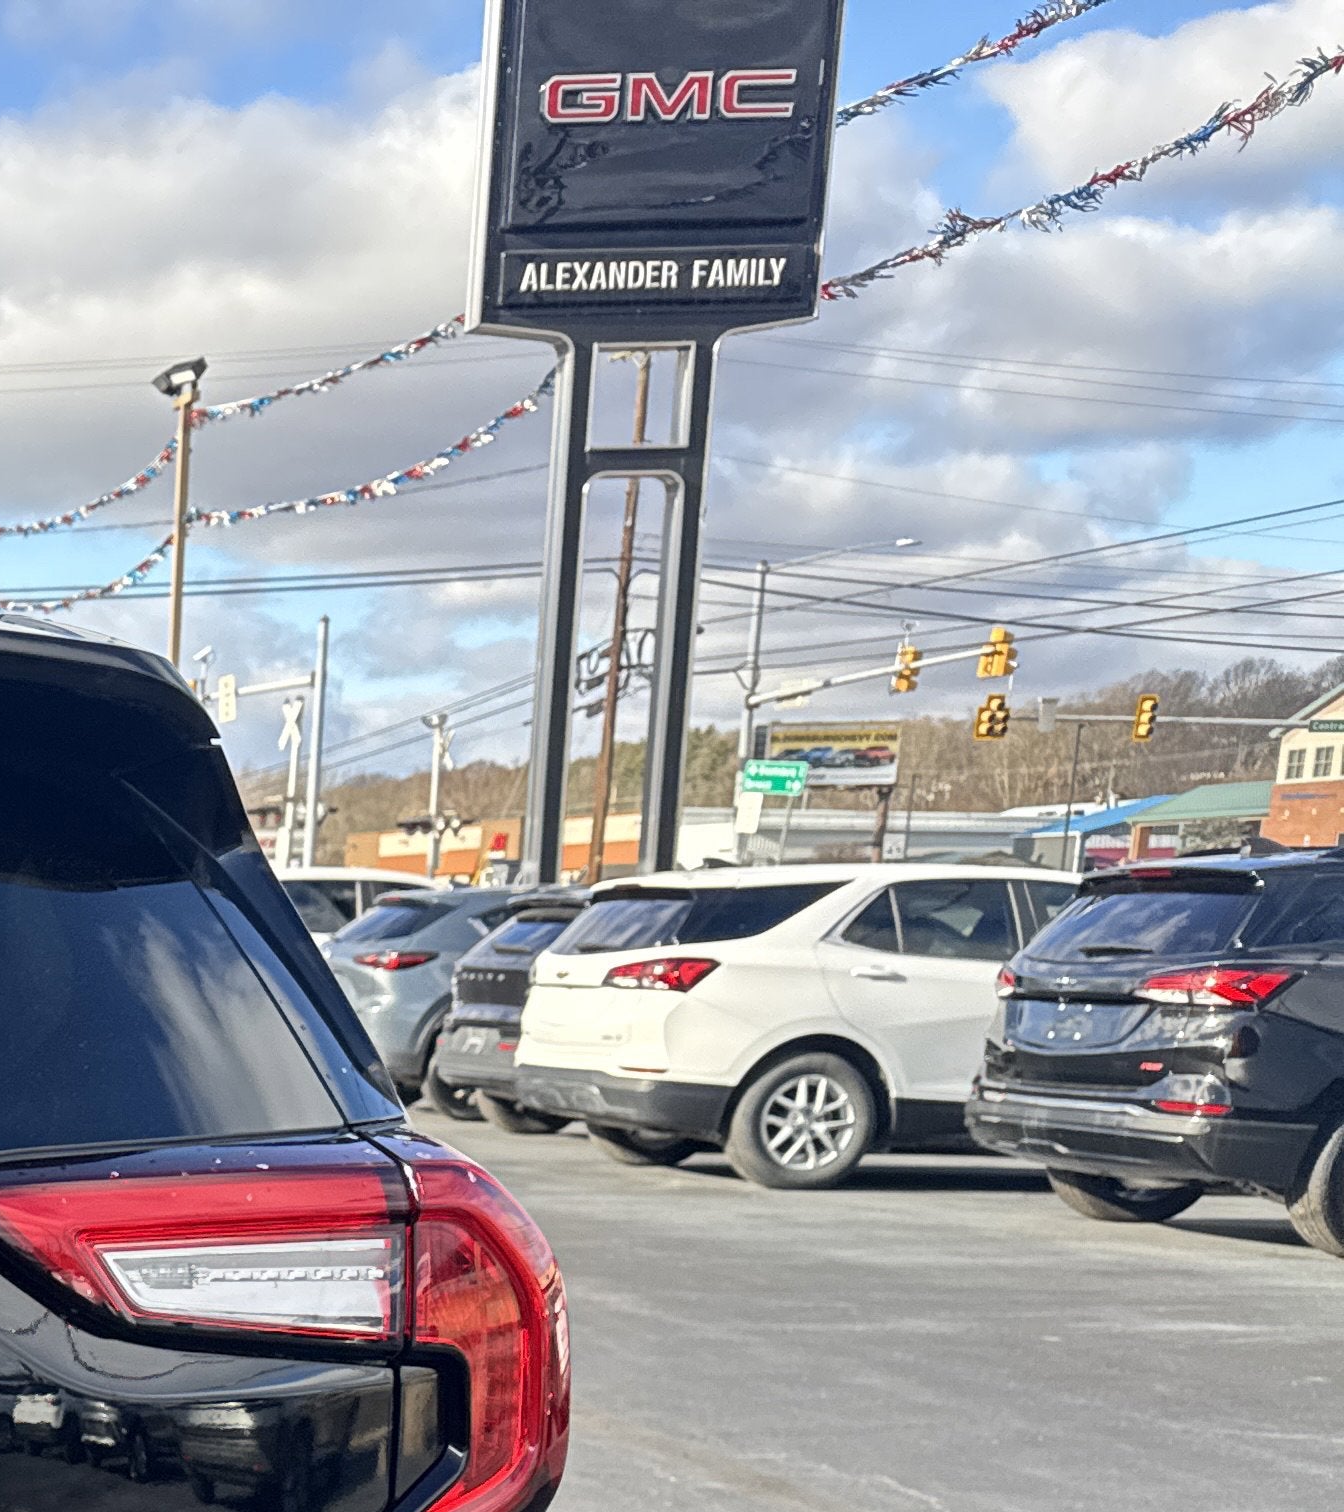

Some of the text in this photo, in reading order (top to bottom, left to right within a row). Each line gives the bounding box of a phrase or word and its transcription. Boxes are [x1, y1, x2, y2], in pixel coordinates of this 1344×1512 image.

[542, 69, 798, 123] GMC
[519, 257, 787, 292] ALEXANDER FAMILY
